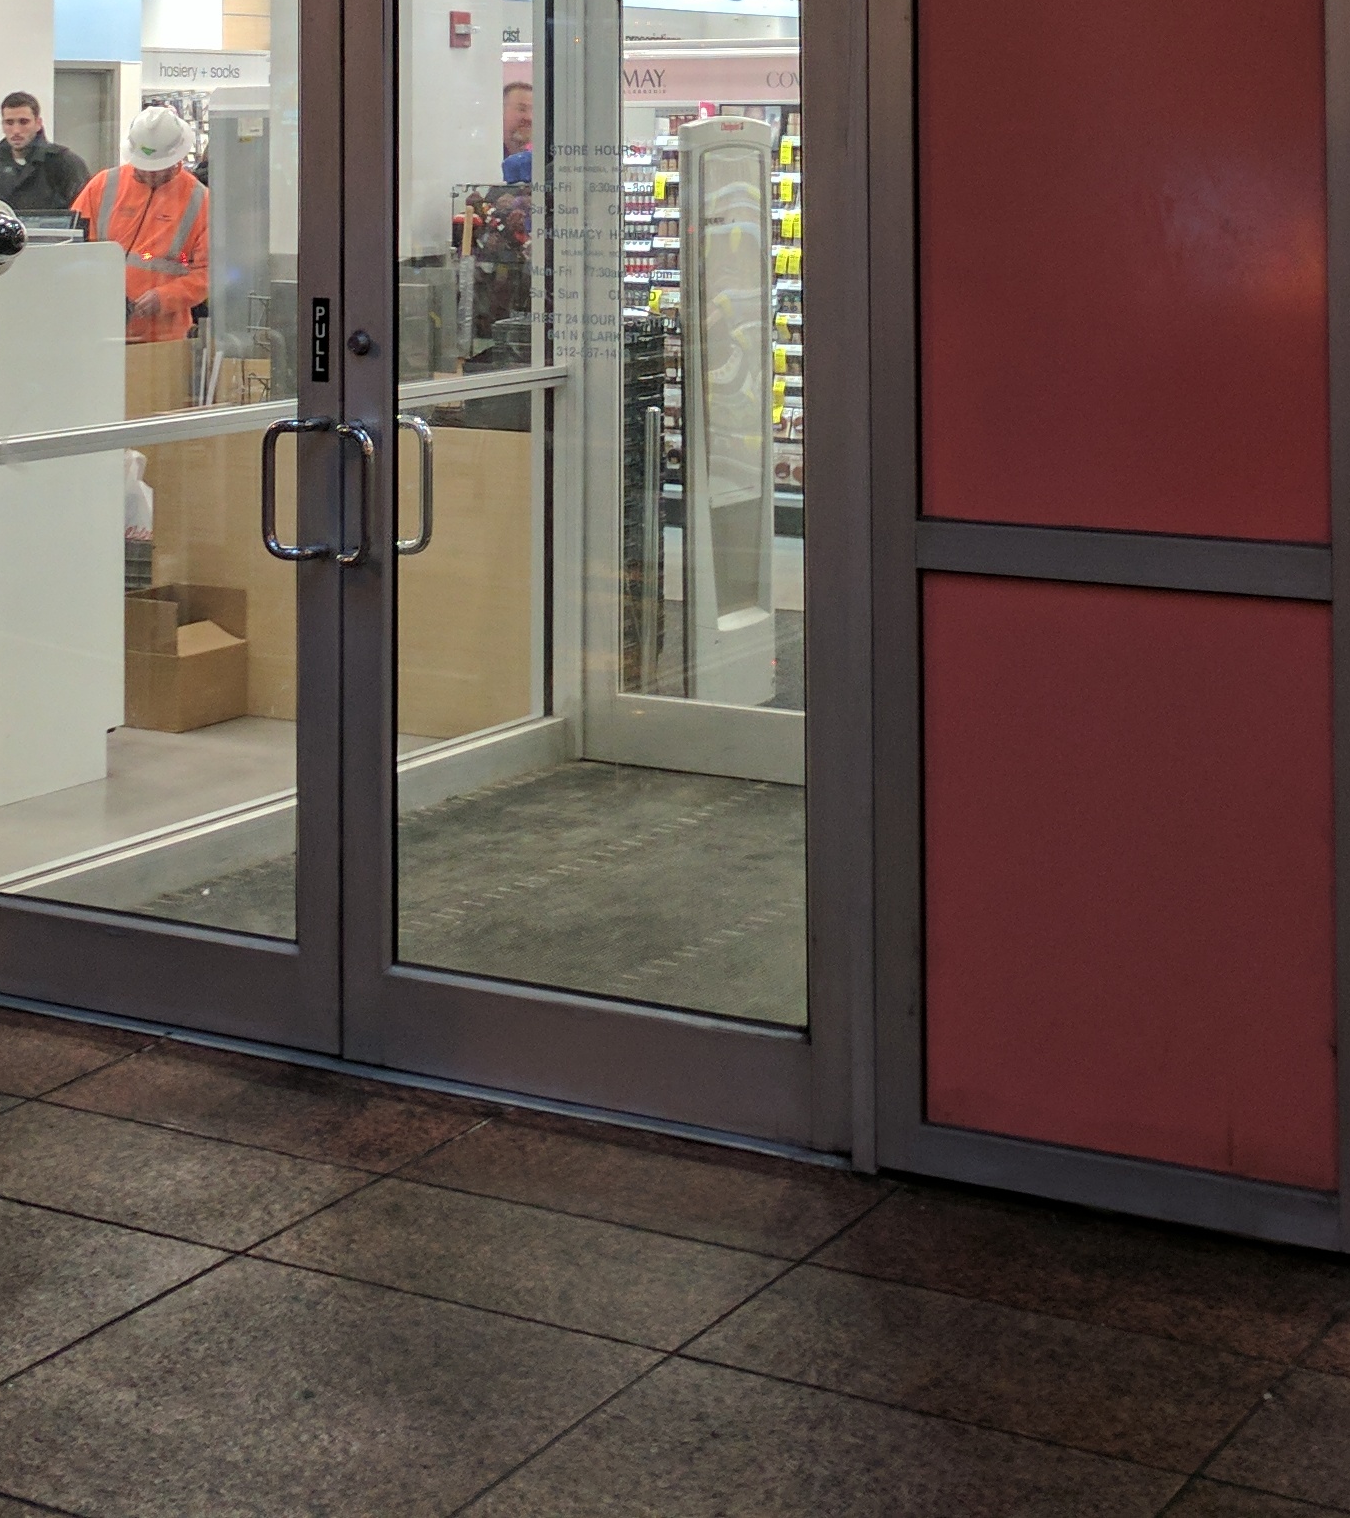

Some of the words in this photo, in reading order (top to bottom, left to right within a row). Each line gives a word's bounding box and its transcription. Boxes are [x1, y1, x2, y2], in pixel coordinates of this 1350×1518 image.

[159, 63, 198, 81] hosiery
[210, 64, 240, 79] socks
[623, 69, 666, 88] MAY
[551, 145, 587, 156] STORE
[595, 146, 637, 156] HOURS
[537, 228, 601, 240] PHARMACY
[566, 314, 578, 324] 24
[315, 306, 326, 372] PULL
